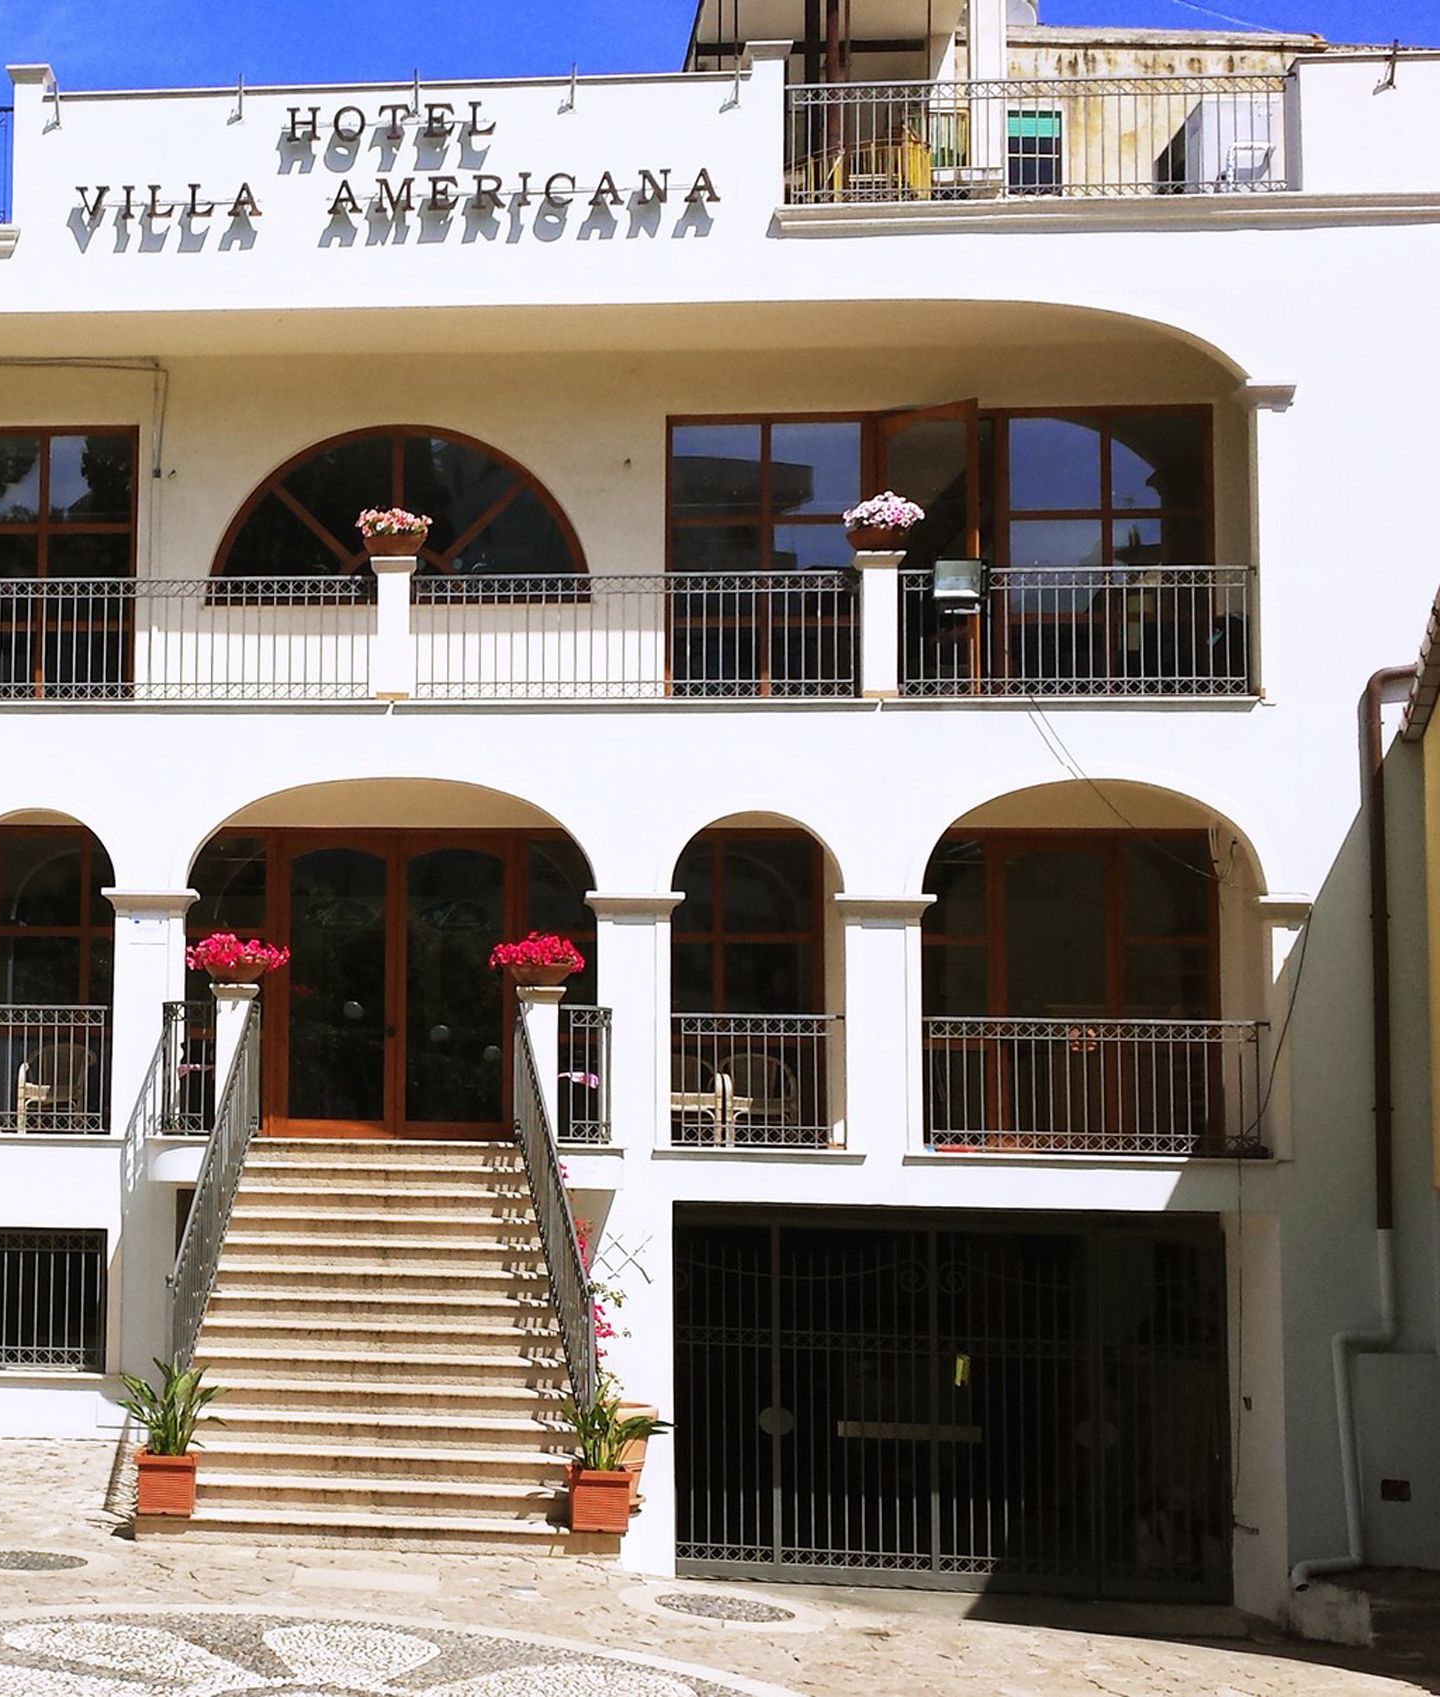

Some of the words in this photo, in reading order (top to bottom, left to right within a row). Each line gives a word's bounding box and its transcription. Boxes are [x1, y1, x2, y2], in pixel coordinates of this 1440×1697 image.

[285, 101, 496, 142] HOTEL
[75, 182, 262, 219] VILLA
[327, 167, 721, 215] AMERICANA
